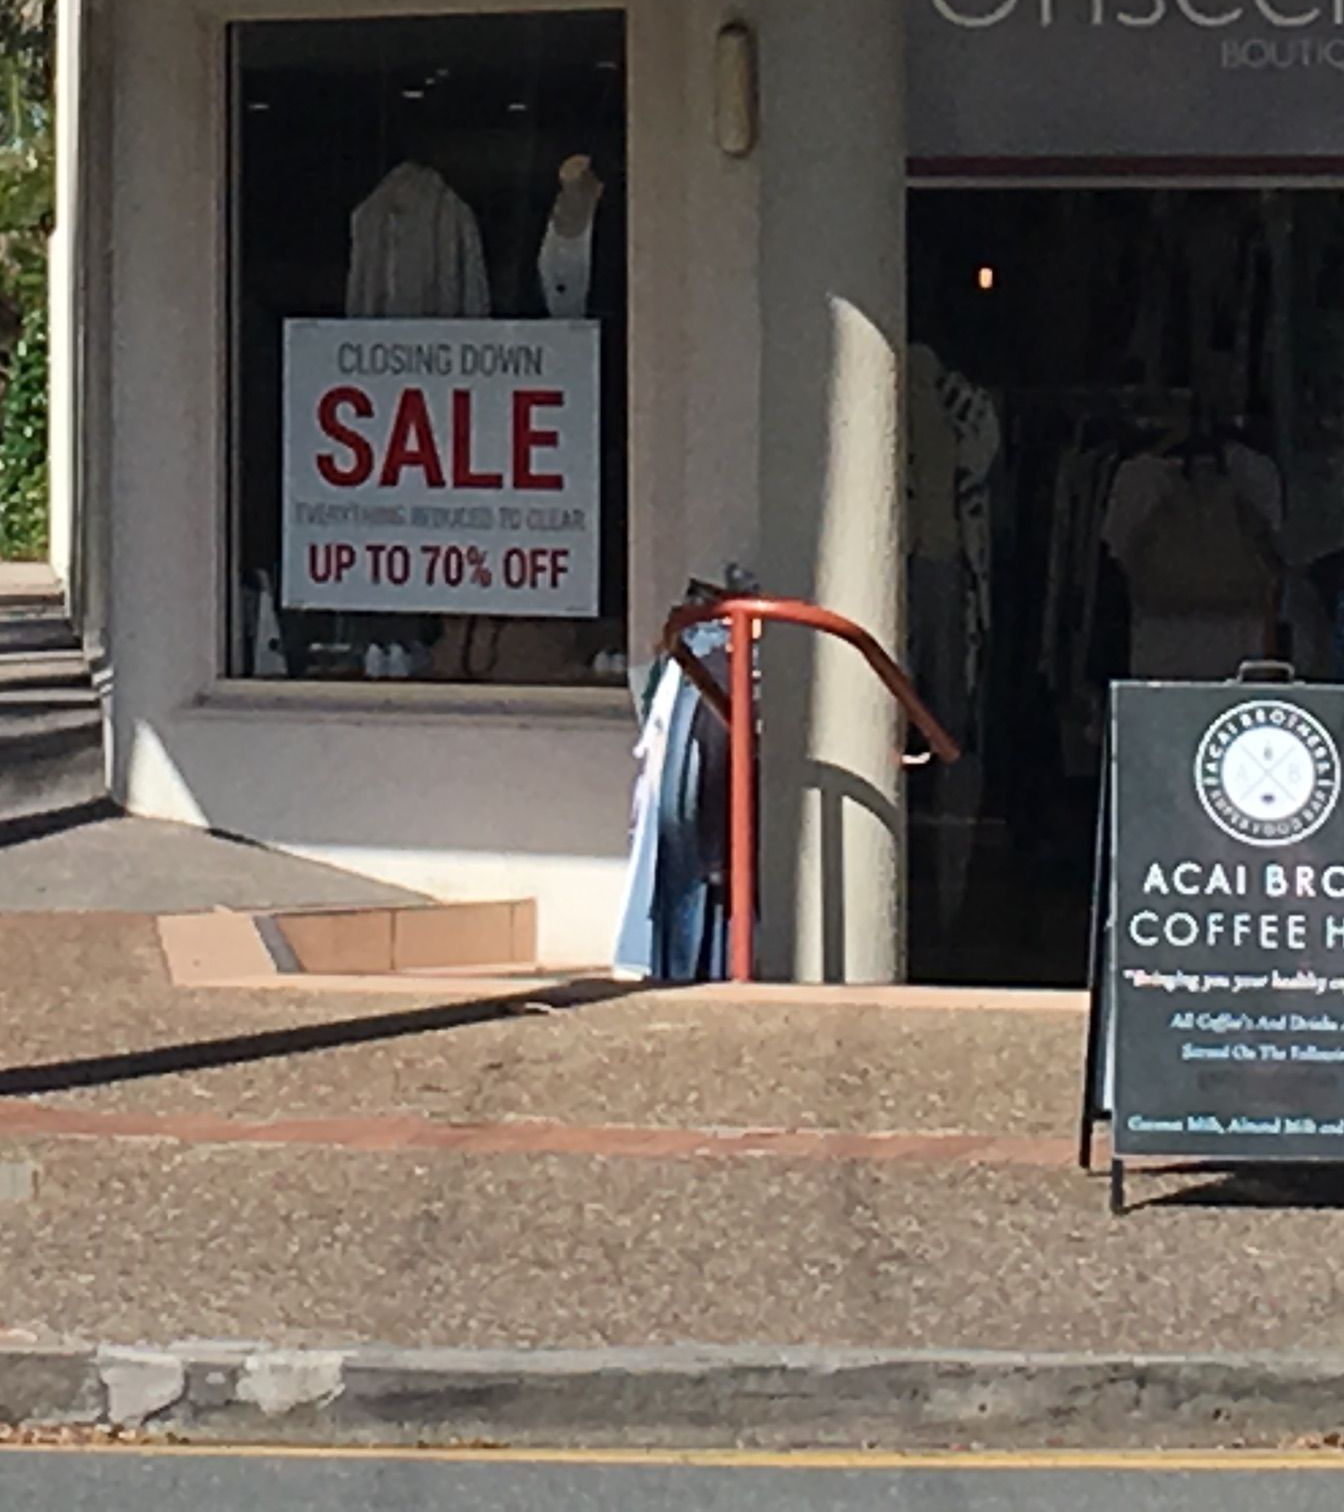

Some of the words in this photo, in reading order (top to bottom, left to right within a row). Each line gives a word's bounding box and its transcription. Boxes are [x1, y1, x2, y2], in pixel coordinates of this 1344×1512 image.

[338, 342, 452, 376] CLOSING
[461, 345, 543, 376] DOWN
[316, 385, 565, 491] SALE
[309, 544, 356, 584] UP
[366, 545, 410, 585] TO
[421, 546, 492, 588] 70%
[503, 548, 570, 589] OFF
[1143, 863, 1247, 896] ACAI
[1129, 910, 1306, 948] COFFEE
